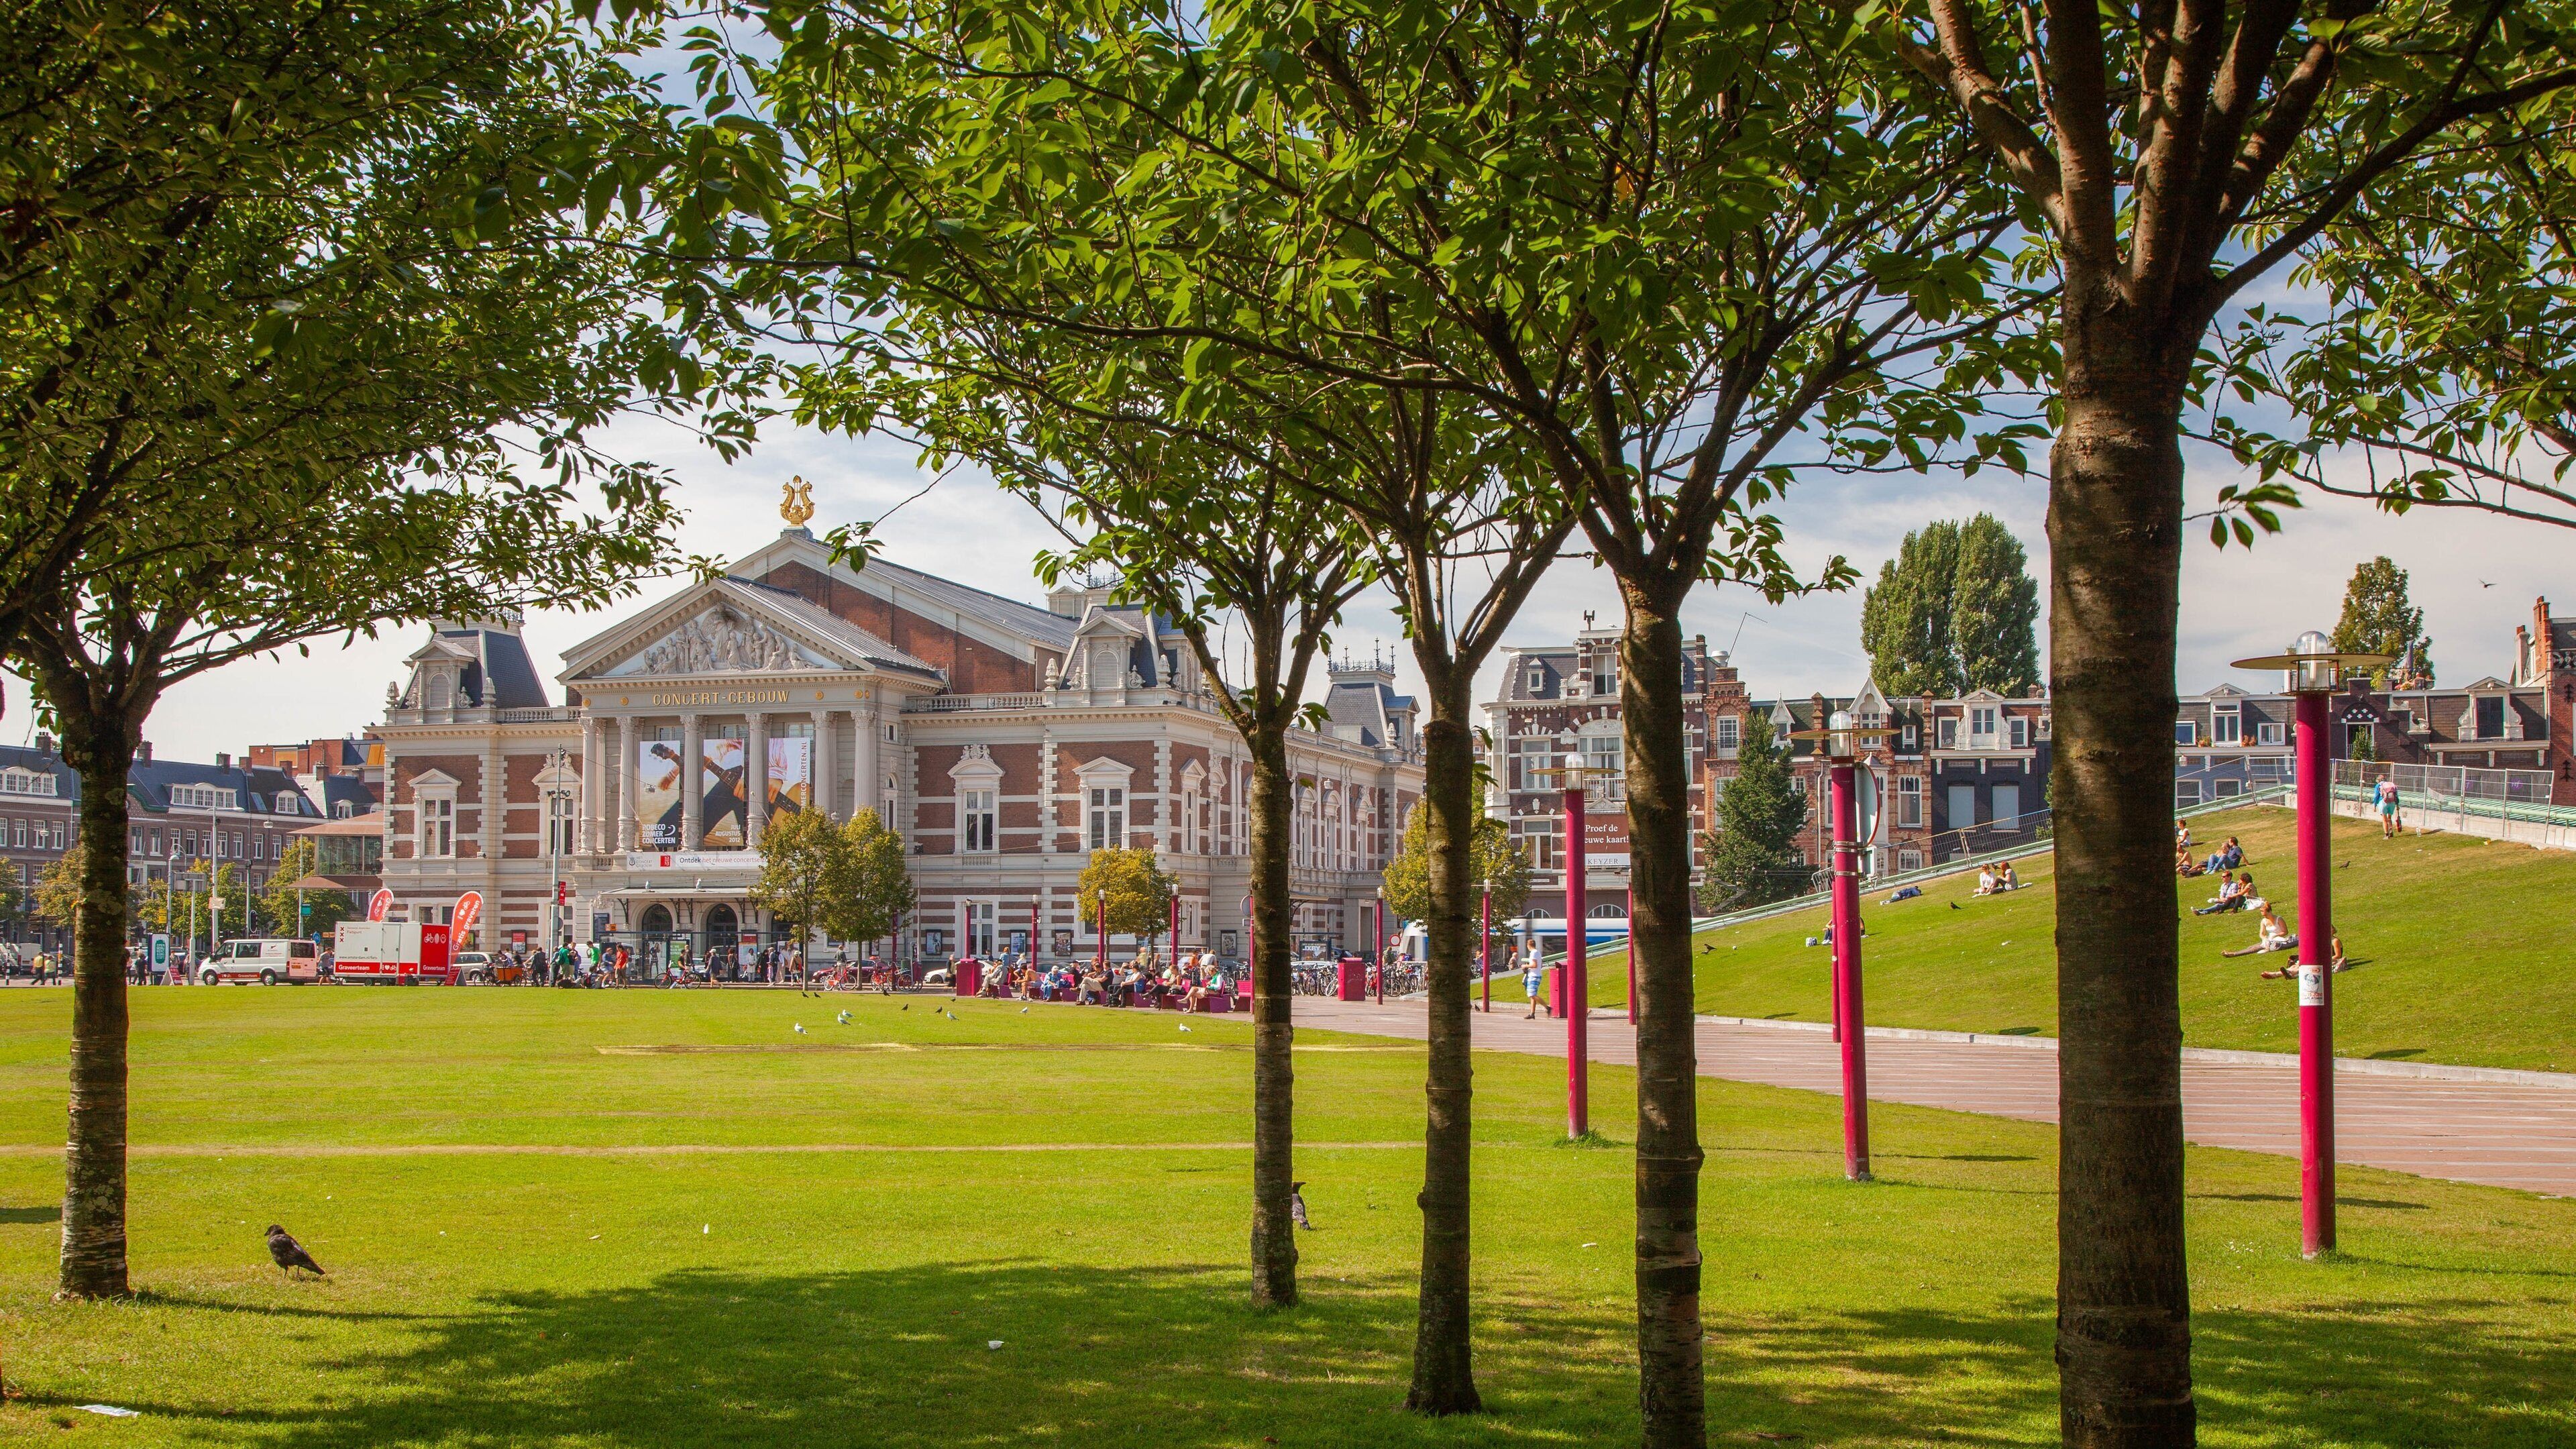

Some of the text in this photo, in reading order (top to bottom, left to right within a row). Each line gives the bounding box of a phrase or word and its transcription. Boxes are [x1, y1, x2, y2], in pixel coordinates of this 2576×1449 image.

[1585, 824, 1618, 832] Proef de
[1607, 835, 1629, 843] kaart!
[453, 930, 466, 951] Gratis
[464, 900, 480, 930] graveren
